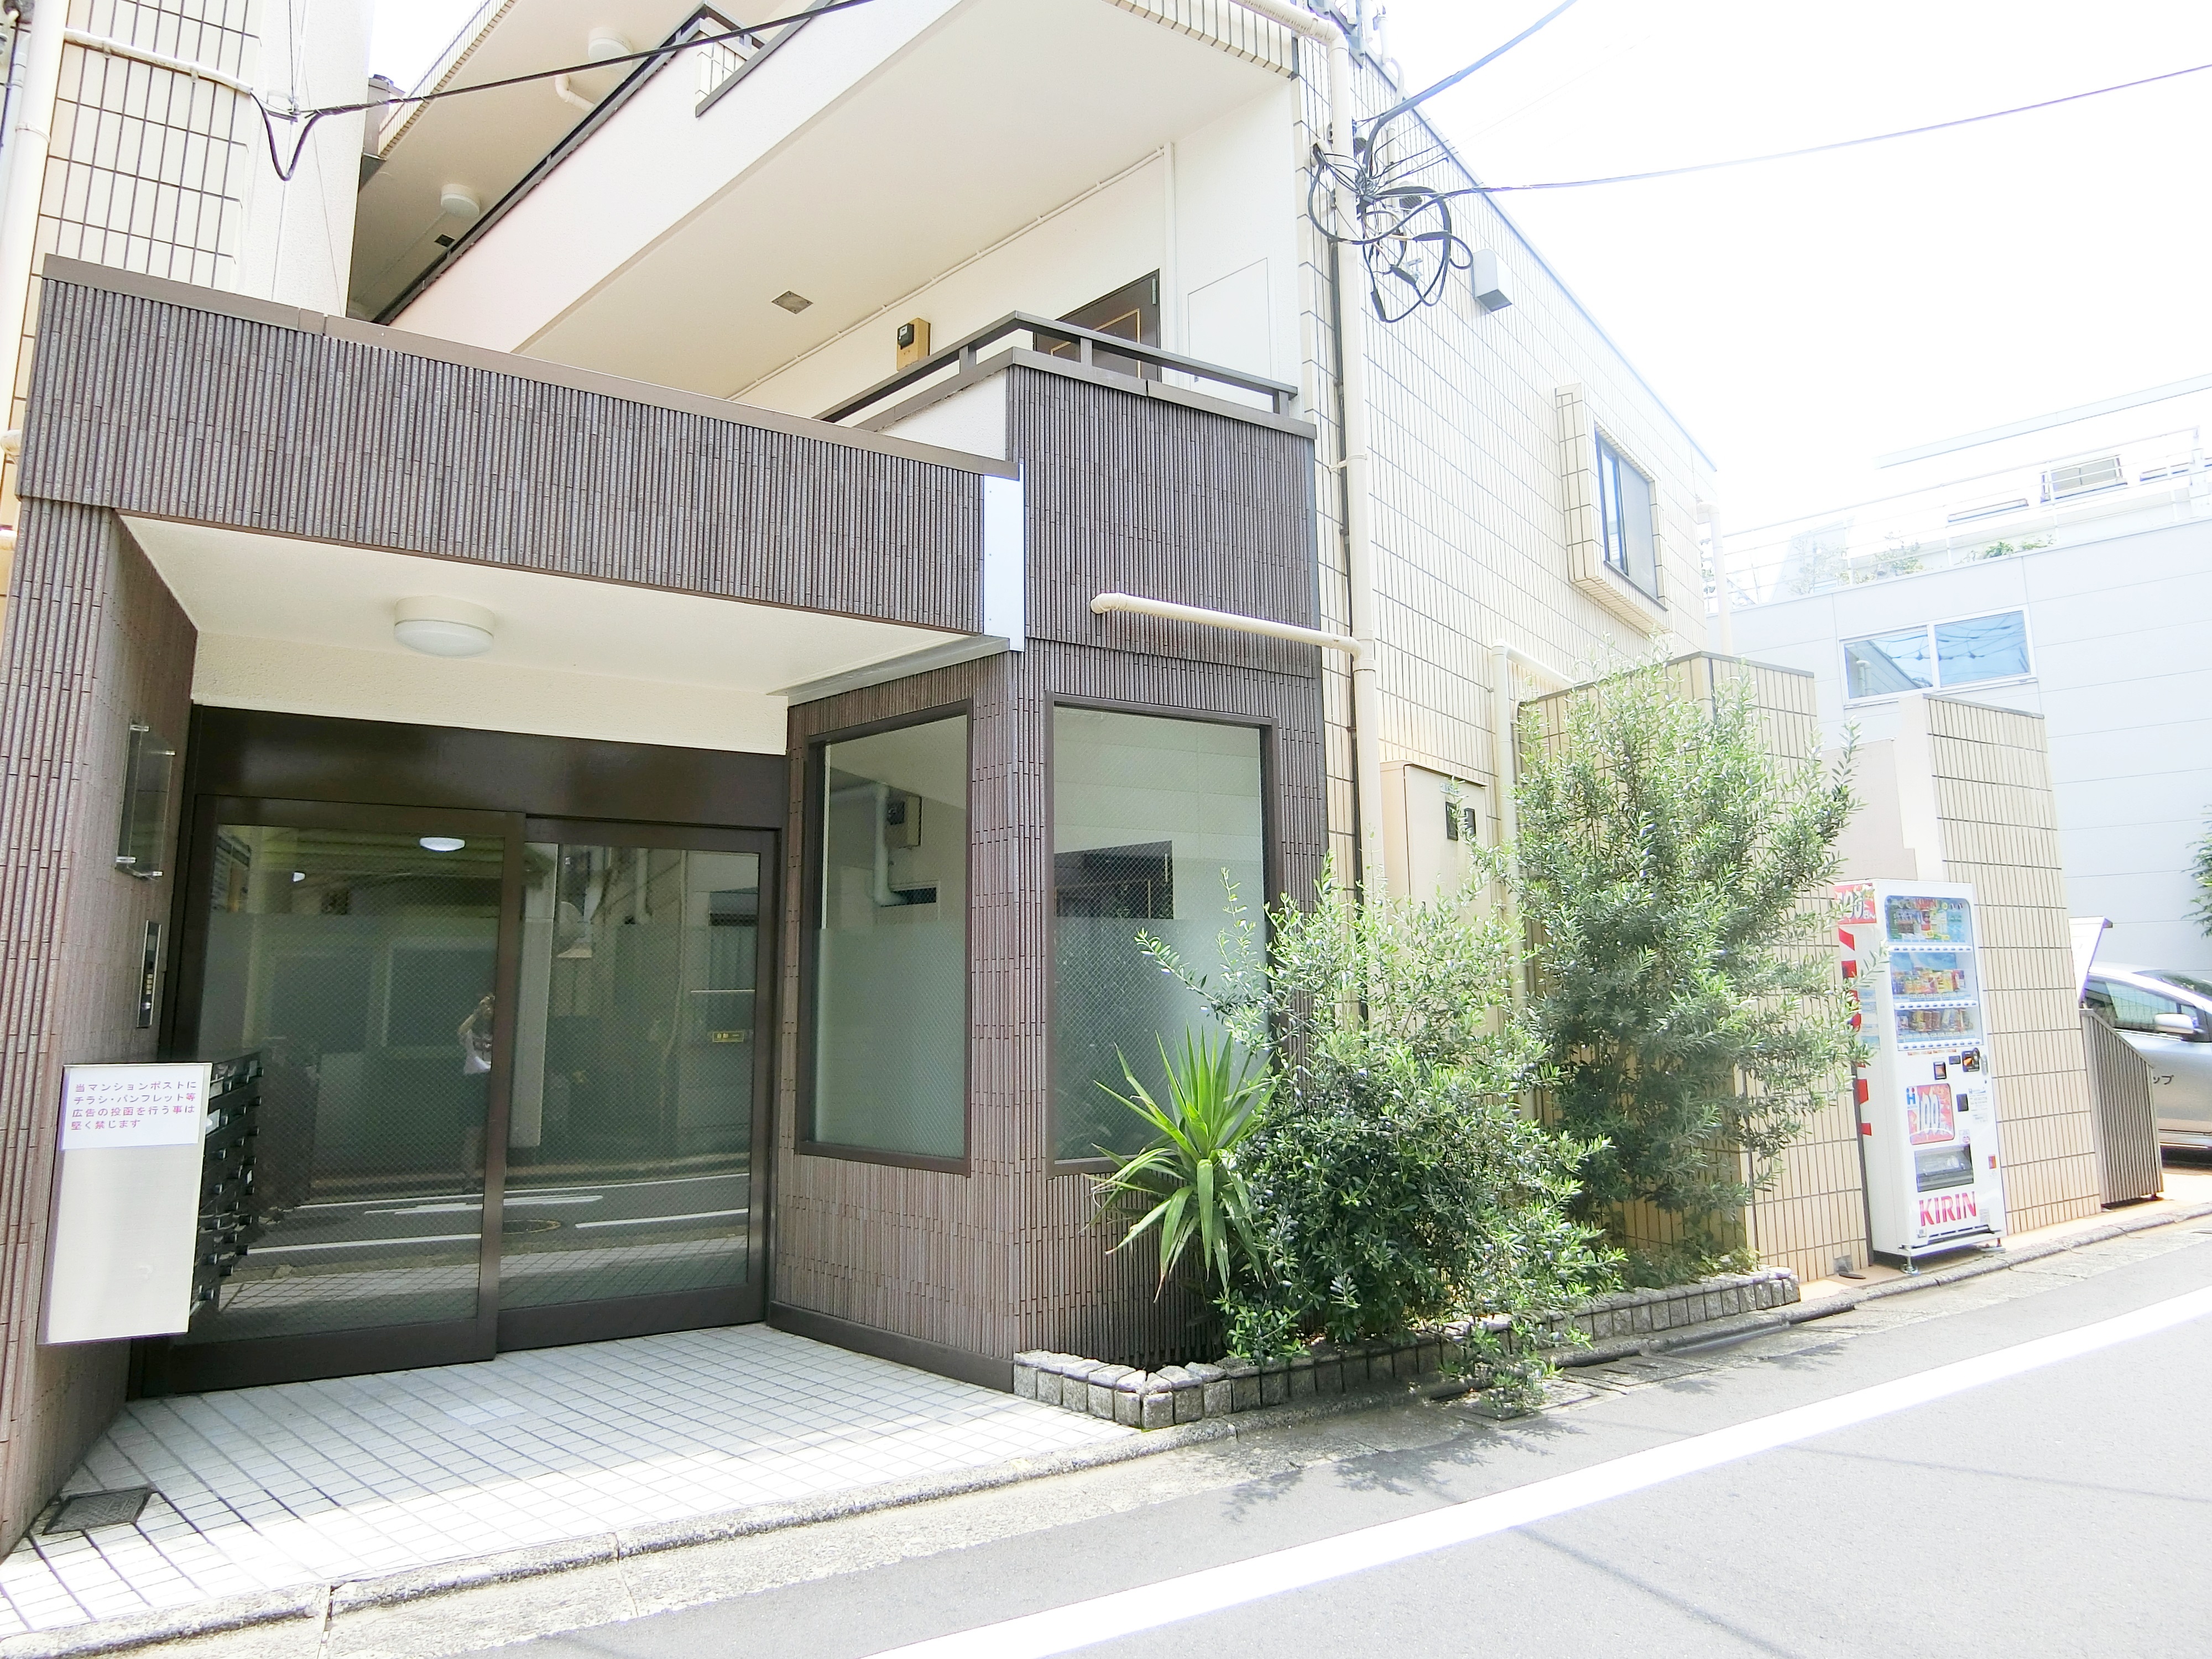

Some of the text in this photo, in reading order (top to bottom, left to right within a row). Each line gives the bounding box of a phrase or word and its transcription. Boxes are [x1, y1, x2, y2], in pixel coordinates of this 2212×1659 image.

[76, 1081, 197, 1093] 当マンションポストに
[74, 1093, 196, 1105] チラシ・パンフレット等
[72, 1105, 195, 1118] 広告の投函を行う事は
[71, 1119, 140, 1130] 堅く禁じます
[1919, 1191, 1976, 1227] KIRIN
